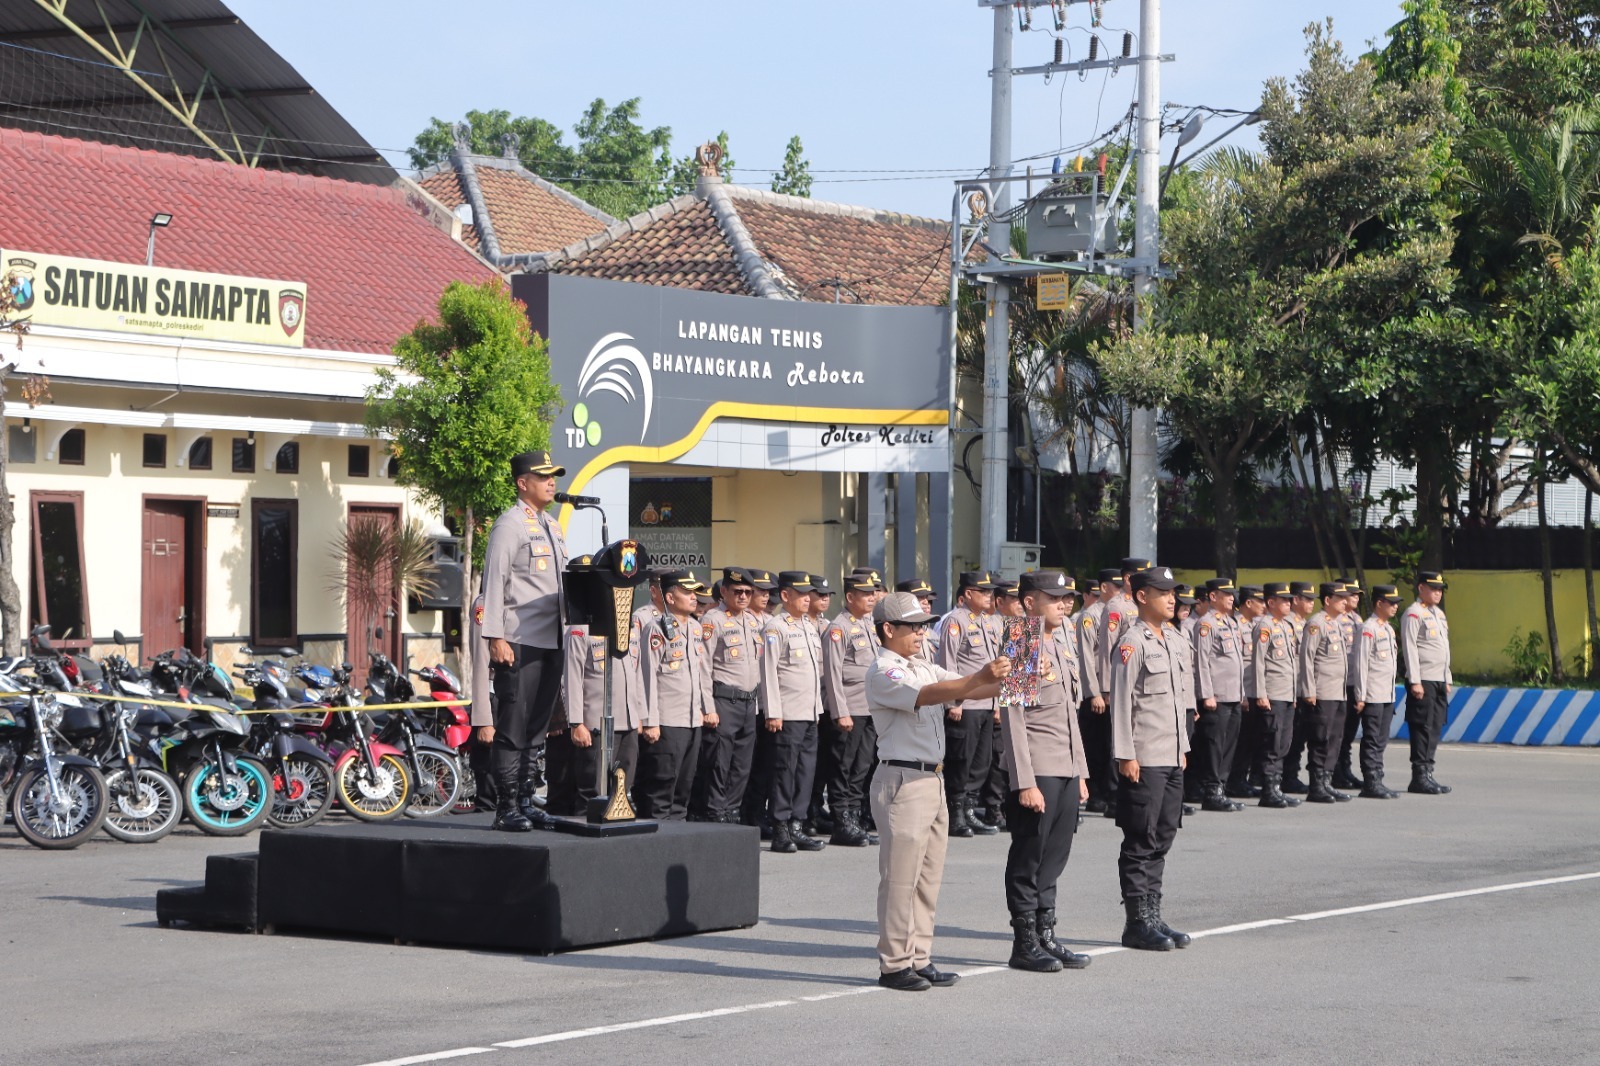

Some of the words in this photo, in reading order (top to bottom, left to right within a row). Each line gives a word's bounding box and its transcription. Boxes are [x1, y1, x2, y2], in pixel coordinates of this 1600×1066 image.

[44, 265, 148, 314] SATUAN
[155, 278, 271, 325] SAMAPTA
[125, 318, 204, 331] satsamapta_polreskediri
[678, 320, 762, 345] LAPANGAN
[770, 328, 823, 349] TENIS
[652, 352, 773, 379] BHAYANGKARA
[786, 361, 865, 387] Reborn
[565, 428, 585, 449] TD
[821, 424, 871, 447] Polres
[878, 425, 934, 446] Kediri
[660, 533, 694, 542] DATANG
[674, 542, 699, 550] TENIS
